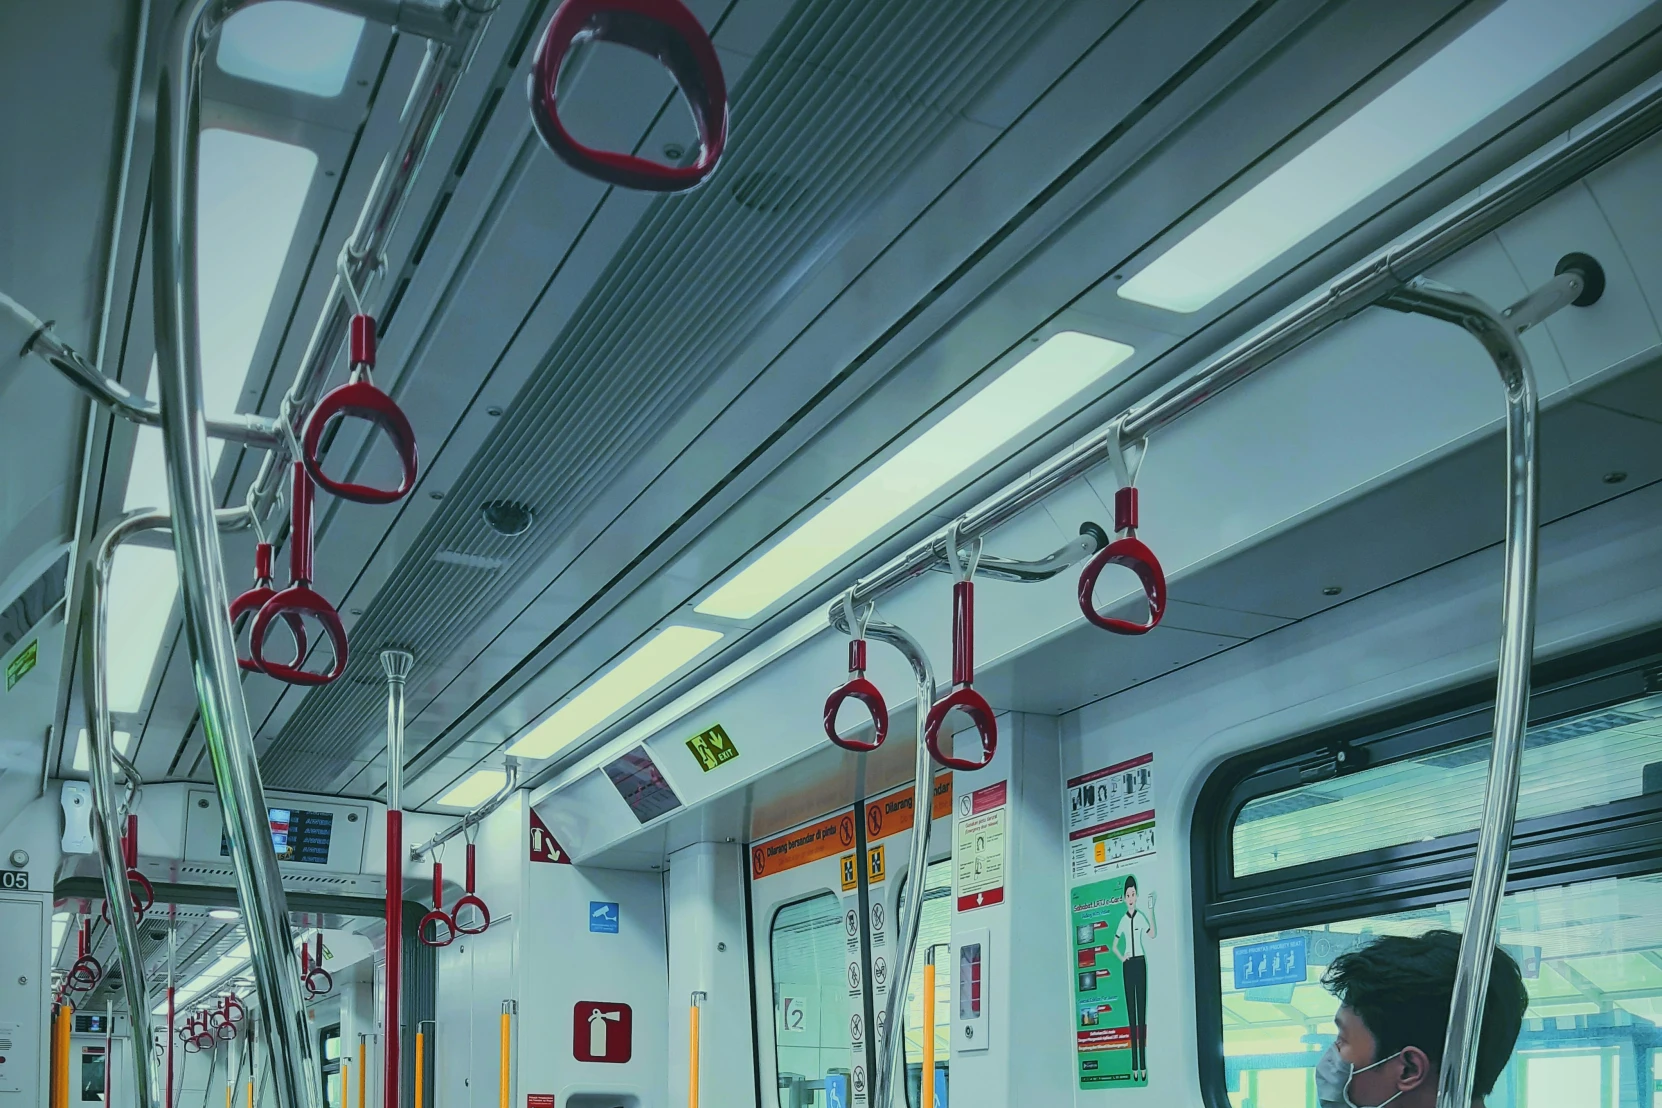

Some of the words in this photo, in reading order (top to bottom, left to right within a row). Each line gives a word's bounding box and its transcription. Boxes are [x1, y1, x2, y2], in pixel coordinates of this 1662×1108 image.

[717, 748, 733, 761] EXIT
[885, 797, 912, 814] Dilarang
[766, 843, 788, 857] Dilarang
[788, 832, 815, 849] bersandar
[816, 828, 821, 840] di
[822, 825, 837, 840] pintu
[3, 872, 27, 888] 05
[791, 1009, 804, 1030] 2
